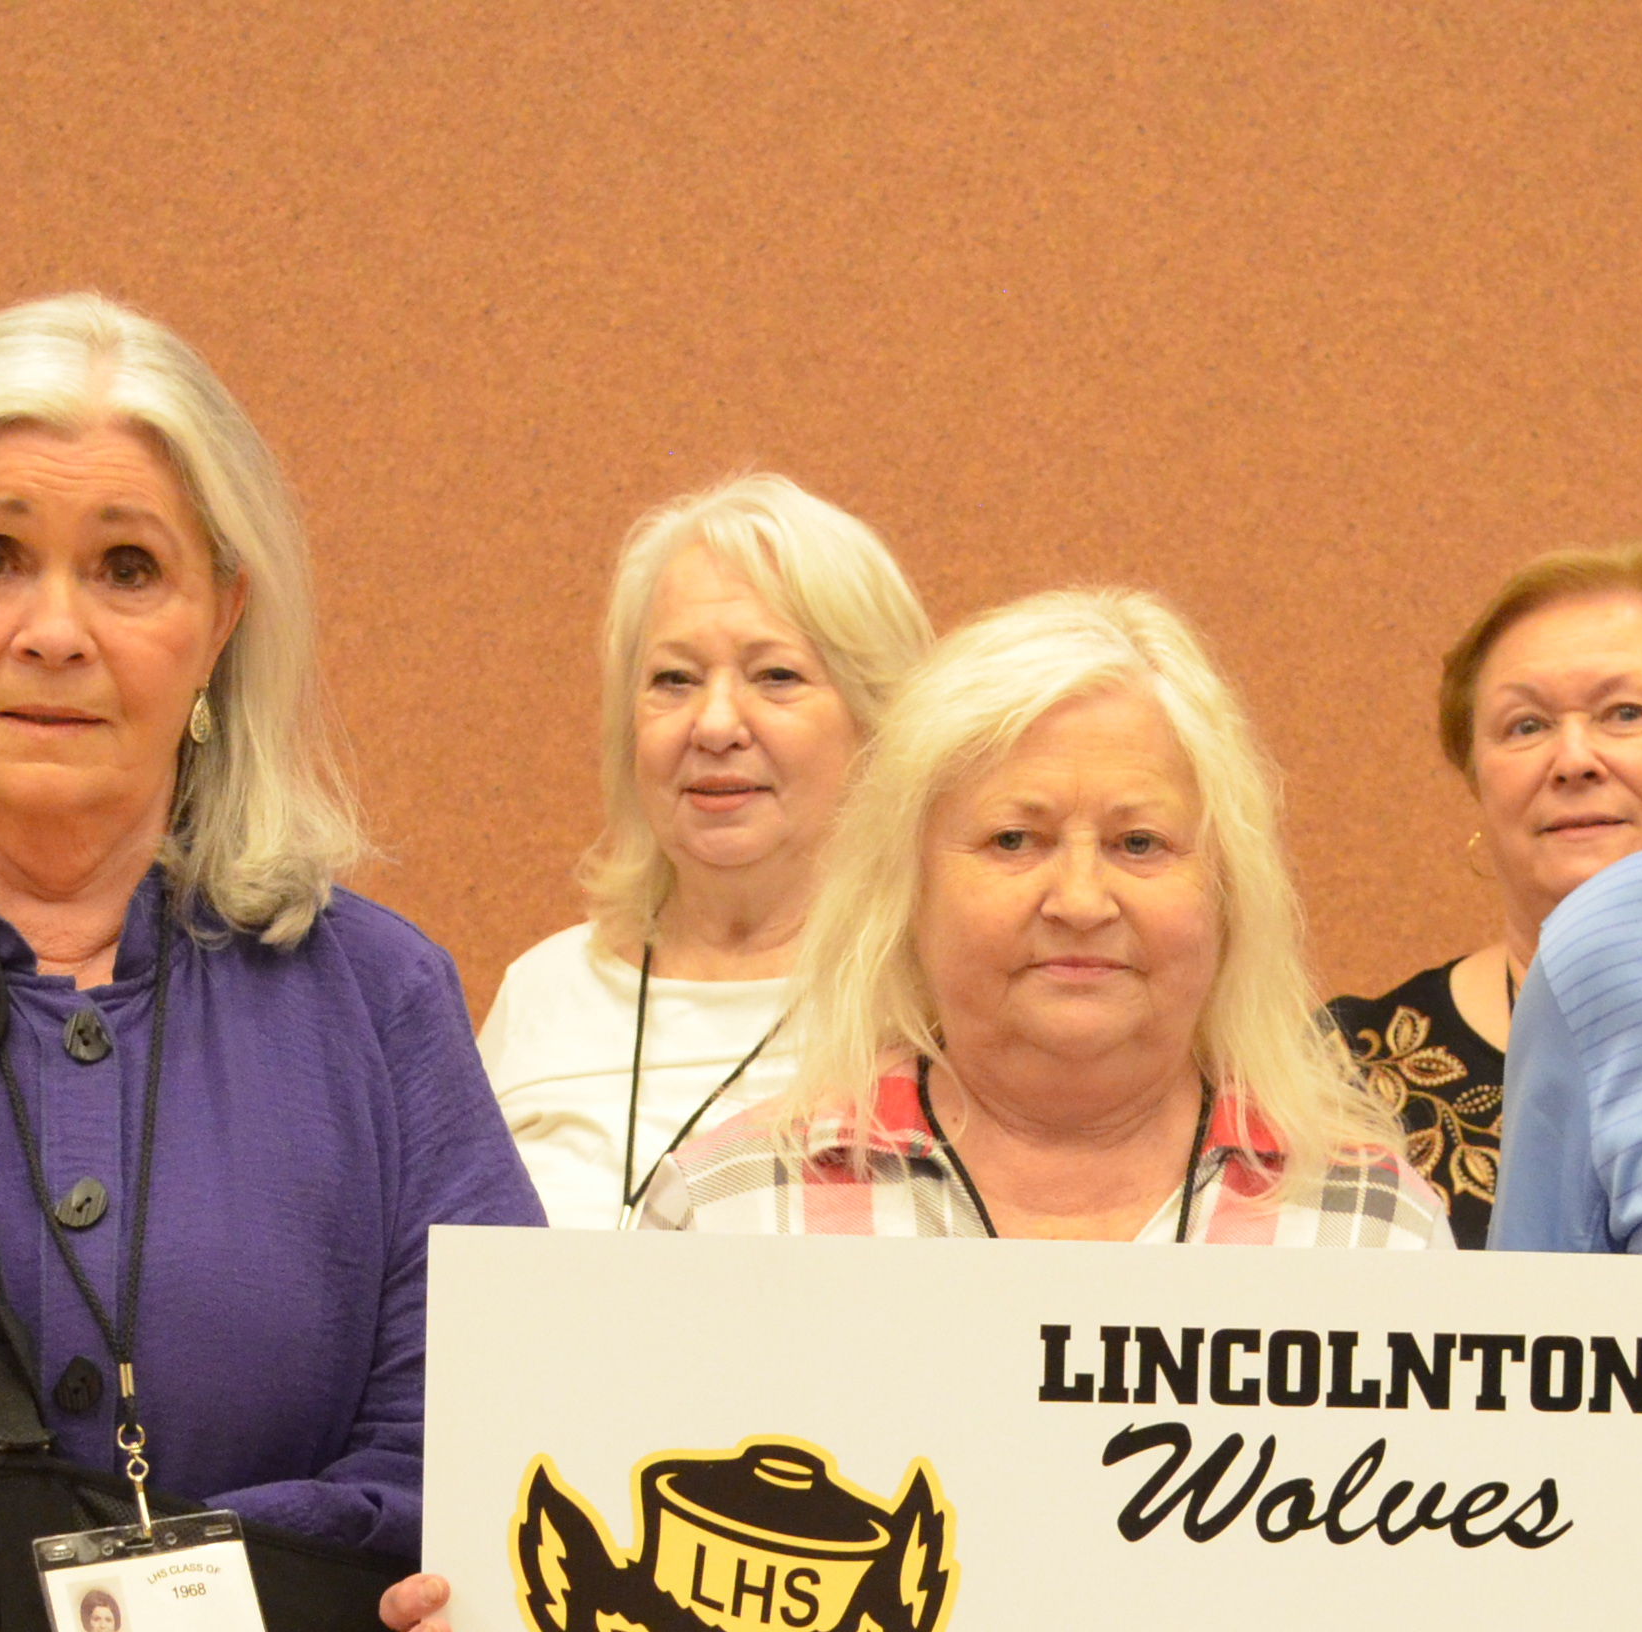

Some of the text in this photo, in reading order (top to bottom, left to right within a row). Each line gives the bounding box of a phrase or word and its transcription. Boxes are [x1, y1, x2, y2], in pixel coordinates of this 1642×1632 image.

[1102, 1422, 1573, 1549] Wolves
[147, 1563, 221, 1585] LHS CLASS OF
[172, 1582, 207, 1599] 1968
[690, 1543, 821, 1628] LHS
